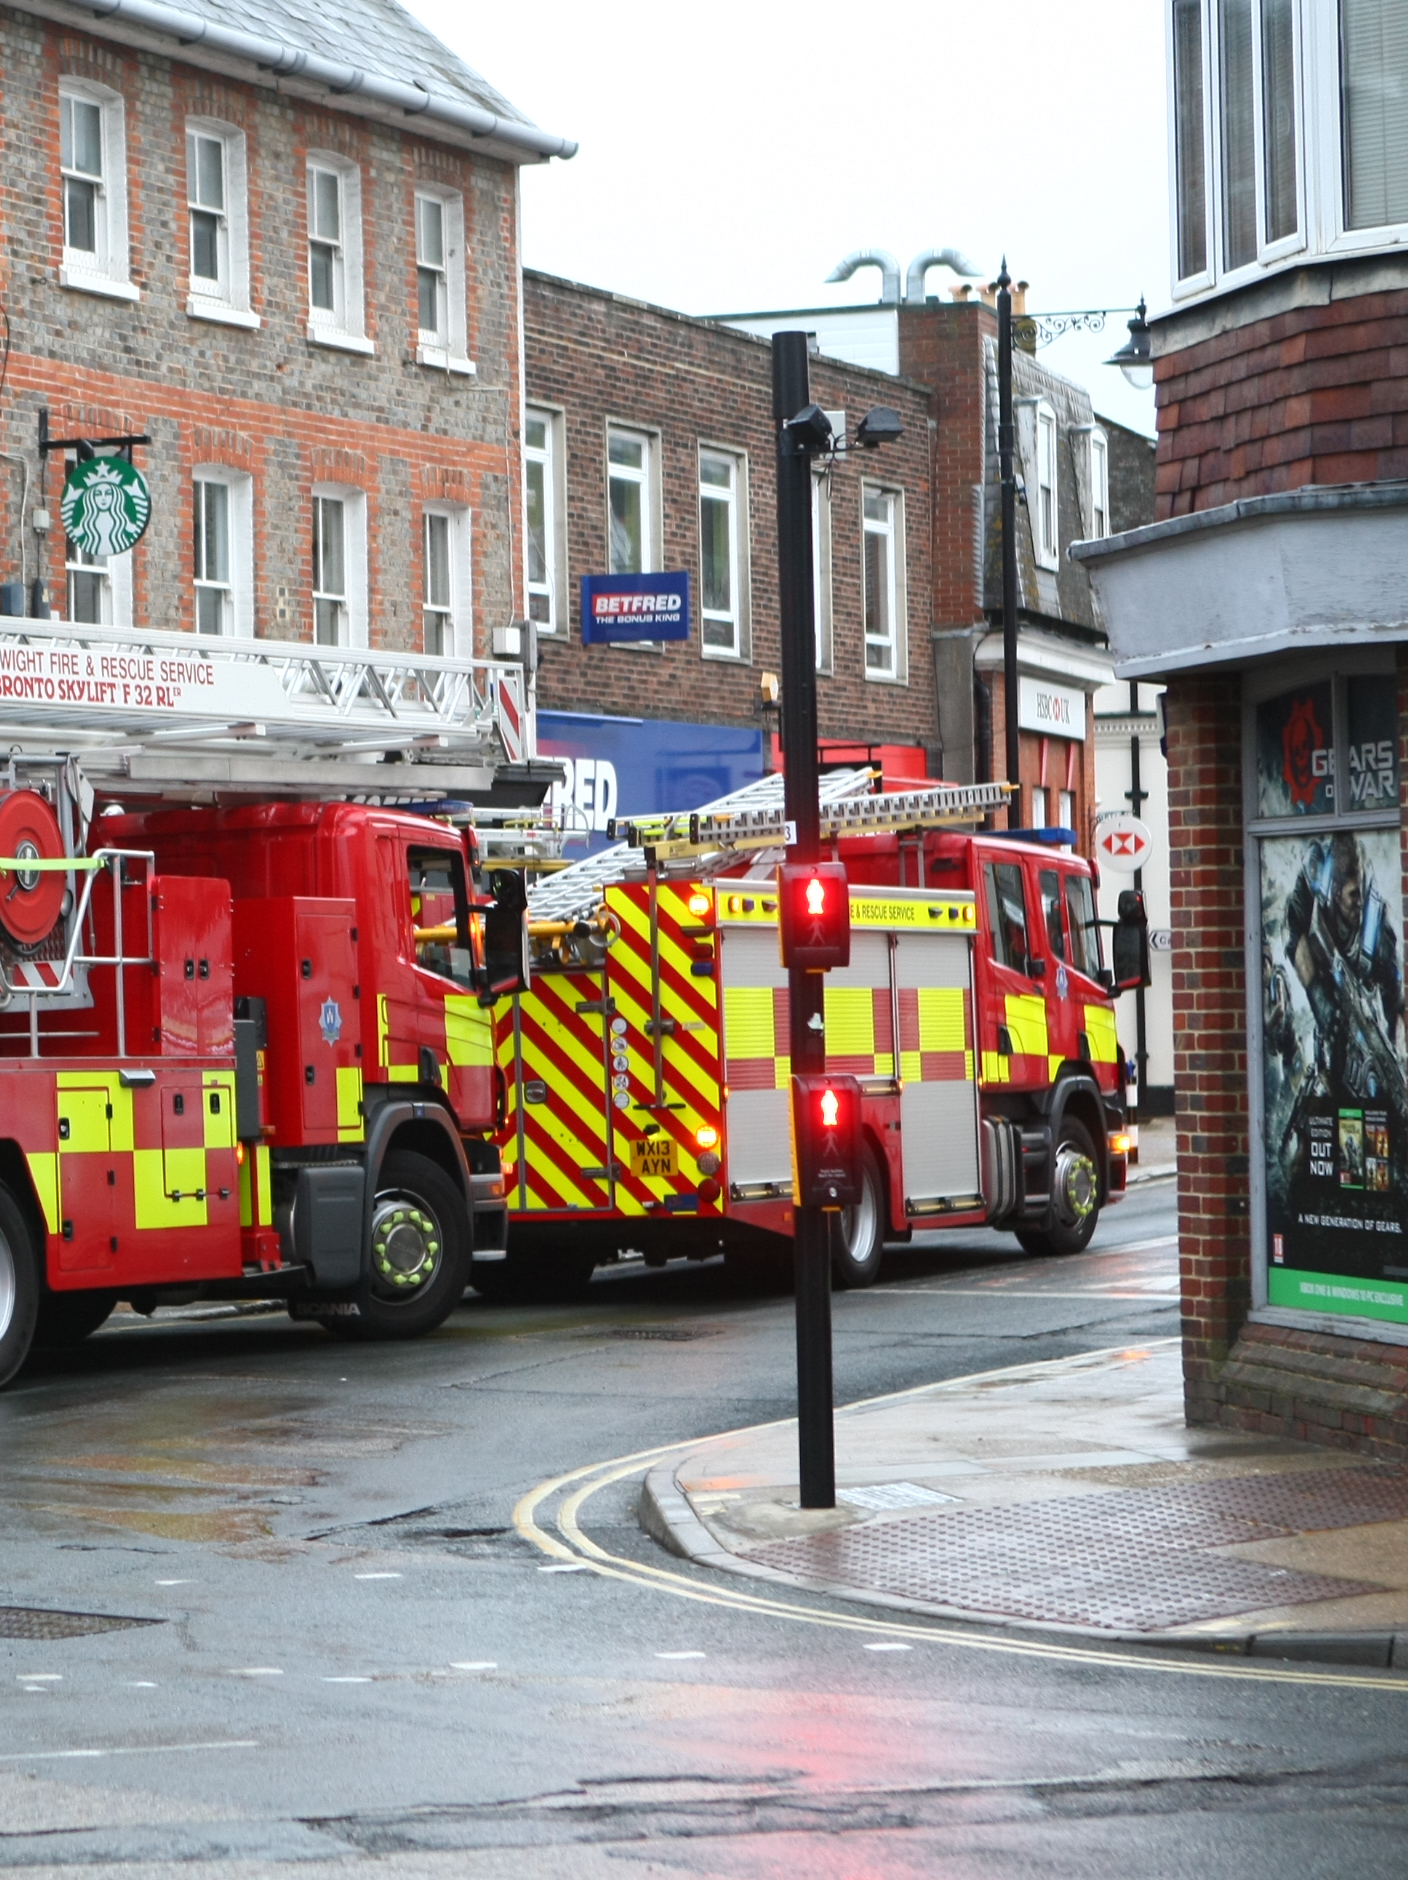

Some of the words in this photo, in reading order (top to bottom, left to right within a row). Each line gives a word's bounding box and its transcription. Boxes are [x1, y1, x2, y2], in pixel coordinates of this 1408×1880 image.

[595, 594, 682, 614] BETFRED
[596, 615, 615, 624] THE
[617, 613, 653, 624] BONUS
[655, 612, 680, 623] KING
[50, 652, 80, 676] FIRE
[86, 656, 96, 677] &
[101, 656, 154, 681] RESCUE
[160, 661, 215, 686] SERVICE
[123, 684, 131, 704] F
[134, 685, 153, 706] 32
[1037, 692, 1052, 721] HSBC
[1061, 698, 1070, 725] UK
[539, 757, 618, 832] RED
[862, 904, 888, 919] RESCUE
[889, 905, 915, 921] SERVICE
[636, 1140, 671, 1156] WX13
[1311, 1141, 1332, 1157] OUT
[642, 1158, 671, 1174] AYN
[1310, 1160, 1334, 1176] NOW
[1298, 1213, 1304, 1223] A
[1304, 1214, 1319, 1225] NEW
[1320, 1215, 1364, 1229] GENERATION
[1365, 1219, 1374, 1230] OF
[1376, 1220, 1403, 1234] GEARS.
[296, 1303, 361, 1316] SCANIA
